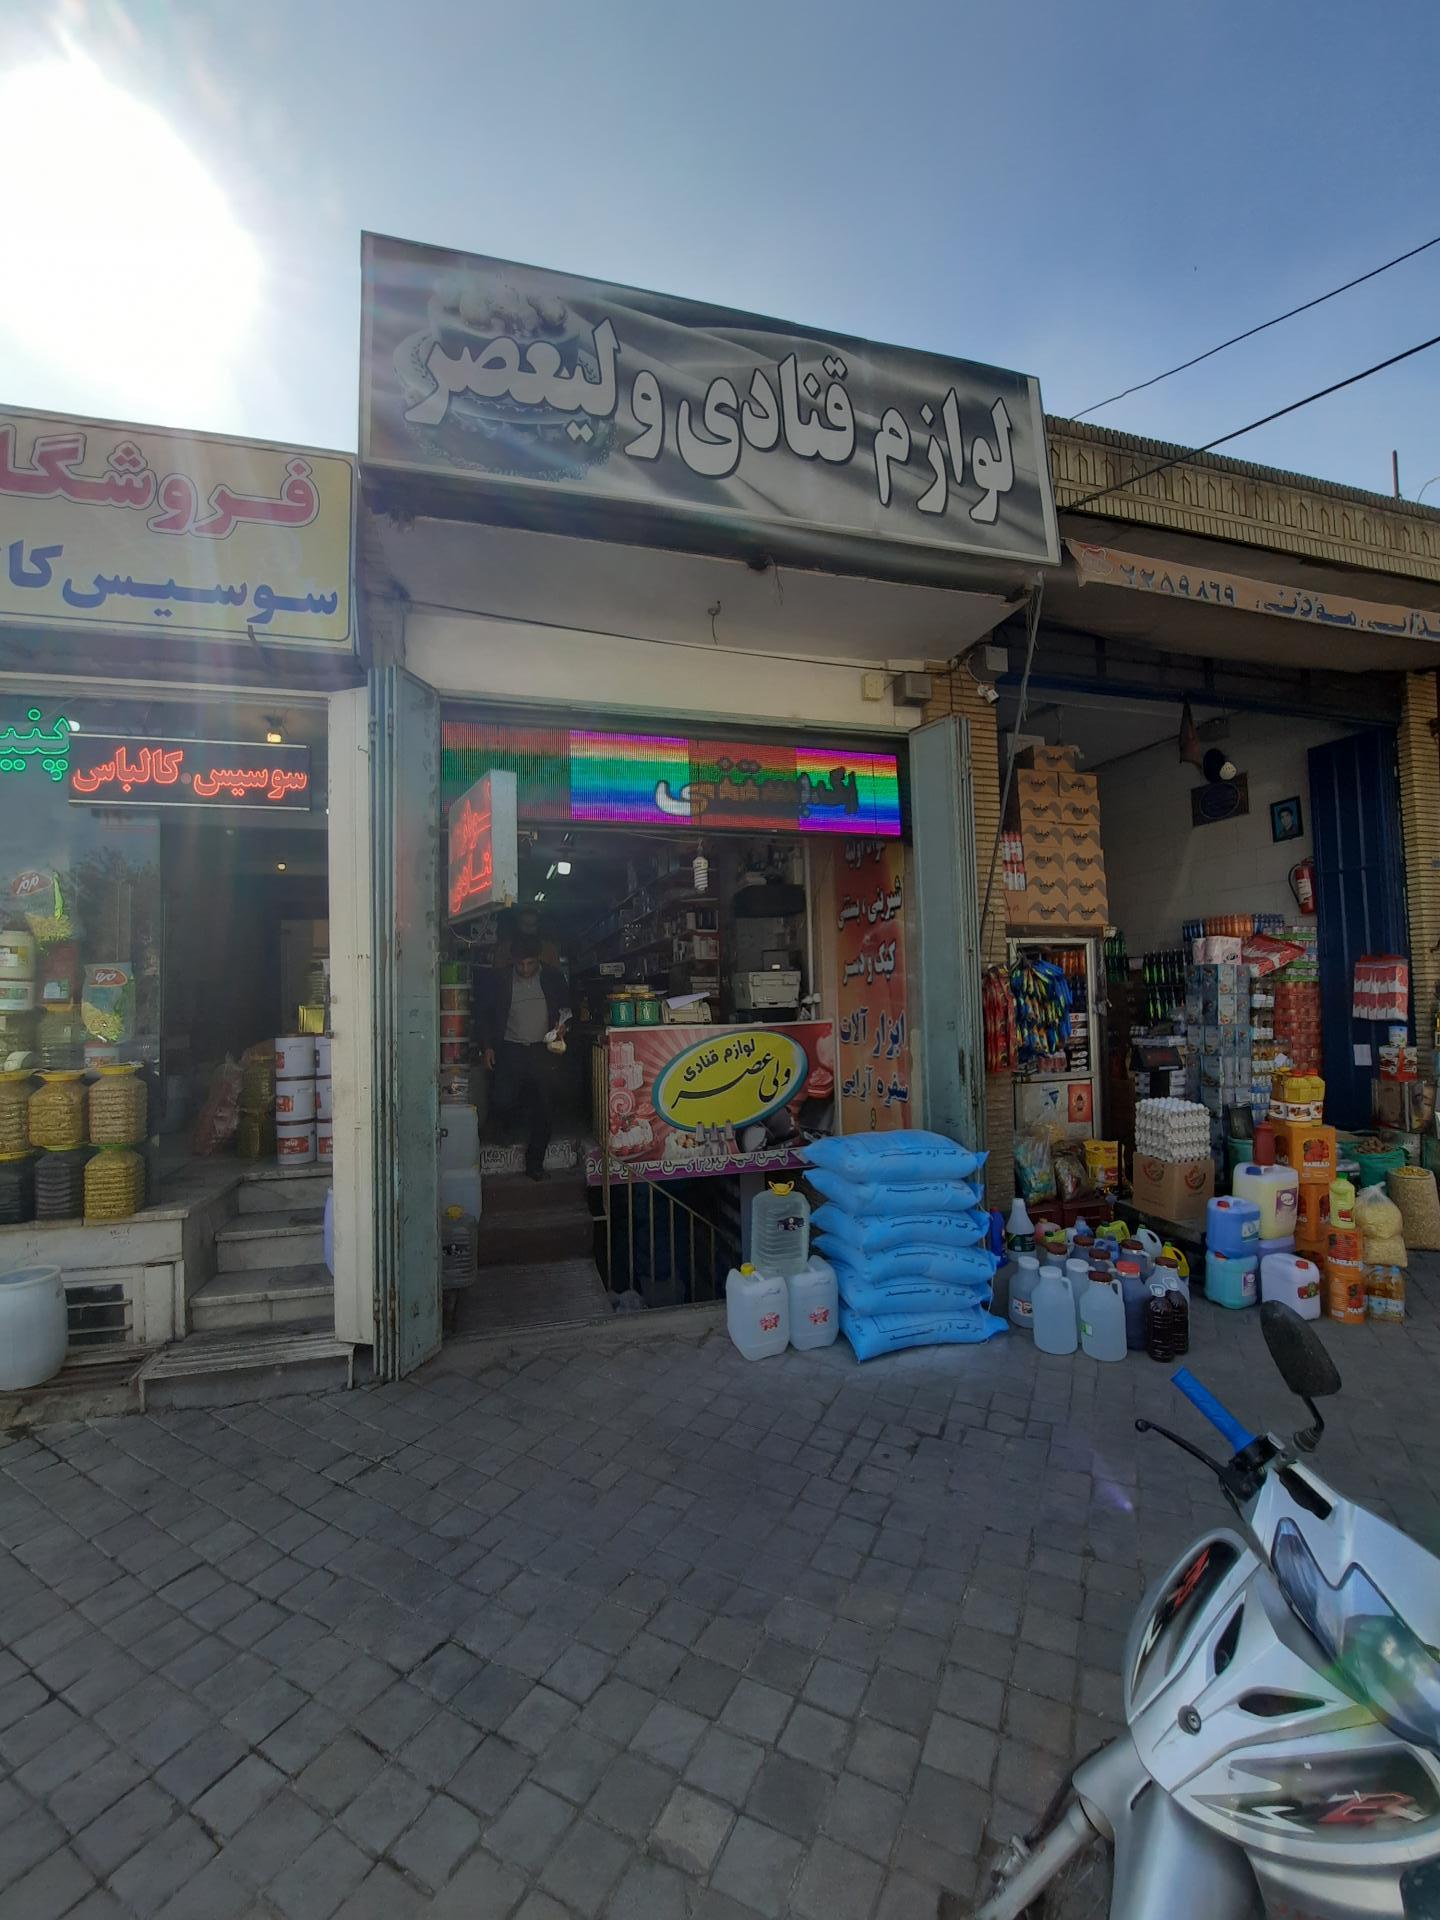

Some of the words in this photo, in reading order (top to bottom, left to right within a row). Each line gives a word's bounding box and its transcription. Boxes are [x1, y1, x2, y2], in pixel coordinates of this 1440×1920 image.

[677, 353, 857, 480] قنادی
[875, 388, 1017, 524] لوازم
[0, 426, 318, 538] فروشگا
[62, 570, 338, 624] سوسیس
[0, 708, 71, 782] پنی
[72, 746, 184, 793] کالباس
[193, 764, 309, 800] سوسیس
[874, 940, 897, 981] کیک
[683, 1050, 719, 1083] قنادی
[723, 1038, 756, 1065] لوازم
[671, 1052, 773, 1110] عصر
[759, 1060, 793, 1104] ولی
